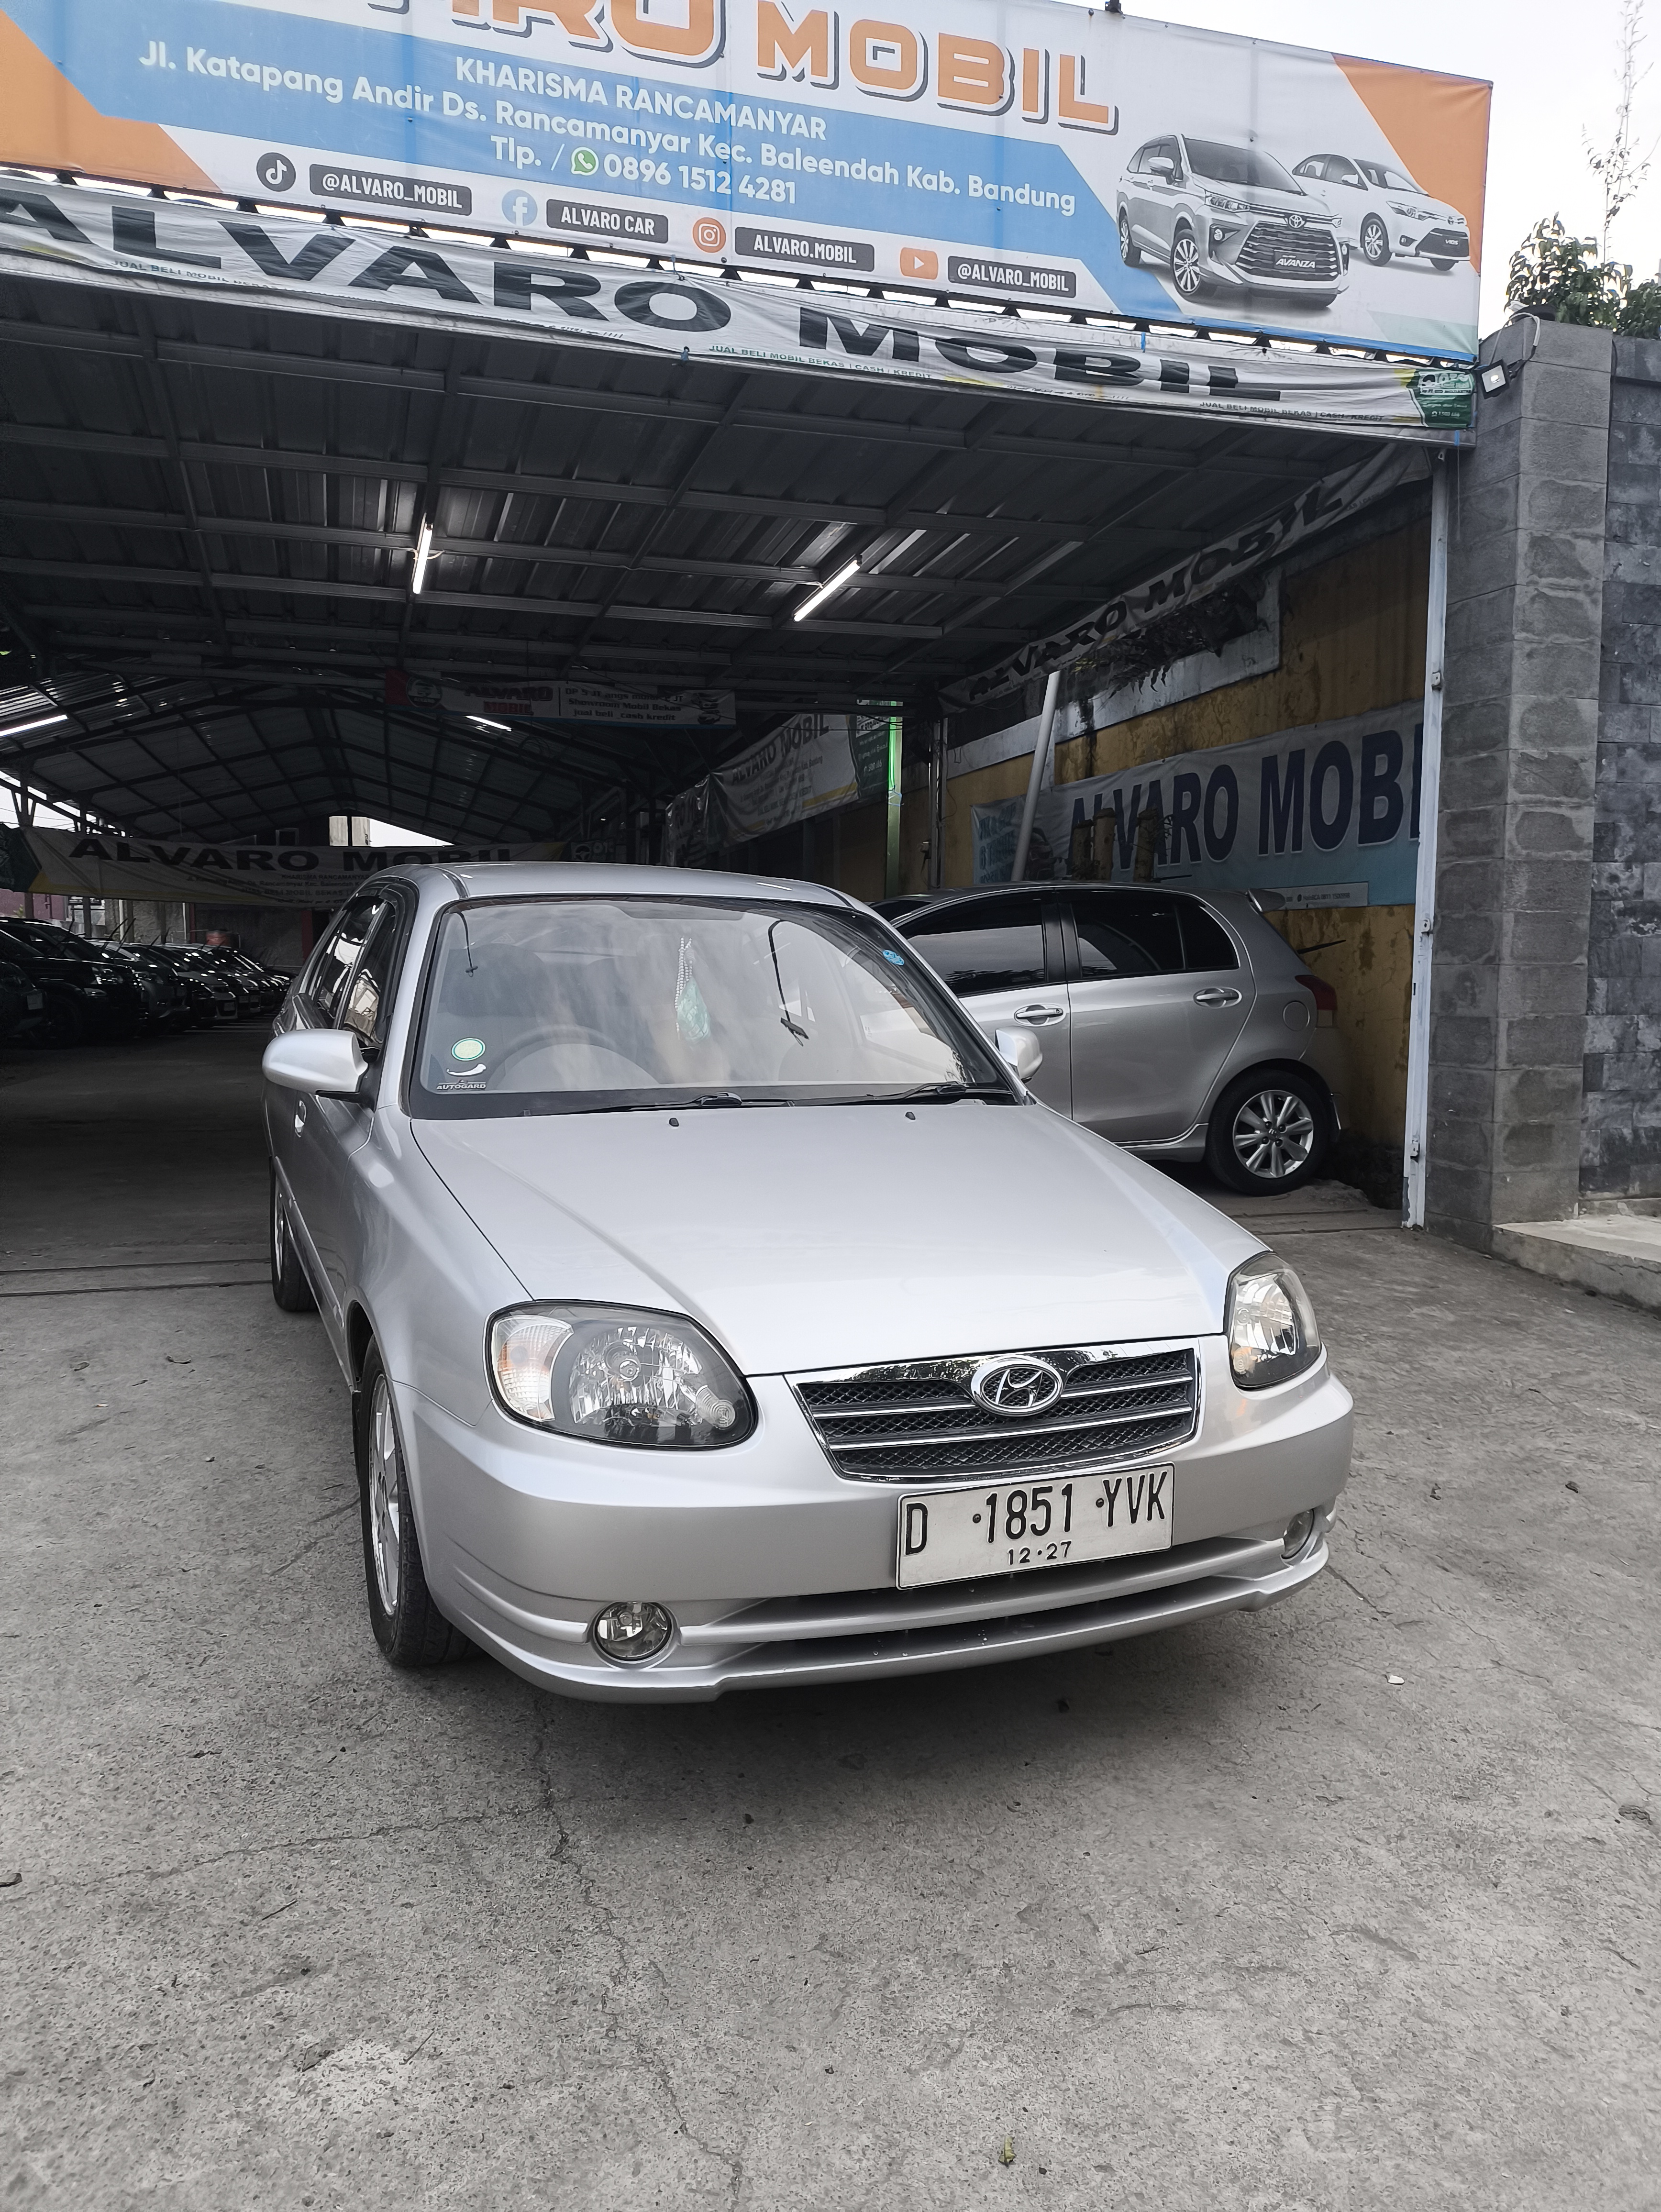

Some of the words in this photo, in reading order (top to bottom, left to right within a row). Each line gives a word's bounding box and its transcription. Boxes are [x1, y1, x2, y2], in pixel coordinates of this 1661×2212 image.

[757, 0, 1118, 135] MOBIL
[456, 56, 608, 106] KHARISMA
[616, 85, 826, 141] RANCAMANYAR
[139, 41, 176, 69] Jl.
[187, 47, 343, 103] Katapang
[353, 77, 433, 113] Andir
[443, 90, 487, 122] Ds.
[496, 100, 691, 157] Rancamanyar
[699, 139, 752, 164] Kec.
[762, 143, 898, 185] Baleendah
[907, 165, 961, 195] Kab.
[968, 175, 1075, 216] Bandung
[490, 135, 542, 169] Tlp.
[604, 154, 671, 183] 0896
[679, 165, 731, 195] 1512
[738, 175, 796, 204] 4281
[322, 174, 462, 209] @ALVARO_MOBIL
[561, 206, 620, 232] ALVARO
[625, 214, 654, 236] CAR
[754, 234, 856, 264] ALVARO.MOBIL
[1276, 258, 1315, 268] AVANZA
[150, 265, 181, 275] BELI
[958, 263, 1069, 292] @ALVARO_MOBIL
[0, 191, 731, 332] ALVARO
[799, 307, 1280, 401] MOBIL
[709, 345, 738, 354] JUAL
[741, 349, 766, 358] BELI
[770, 353, 805, 363] MOBIL
[808, 358, 845, 368] BEKAS
[855, 365, 885, 374] CASH
[569, 698, 620, 708] Showroom
[68, 838, 319, 872] ALVARO
[905, 1503, 928, 1556] D
[986, 1483, 1073, 1544] 1851
[1102, 1471, 1168, 1528] YVK
